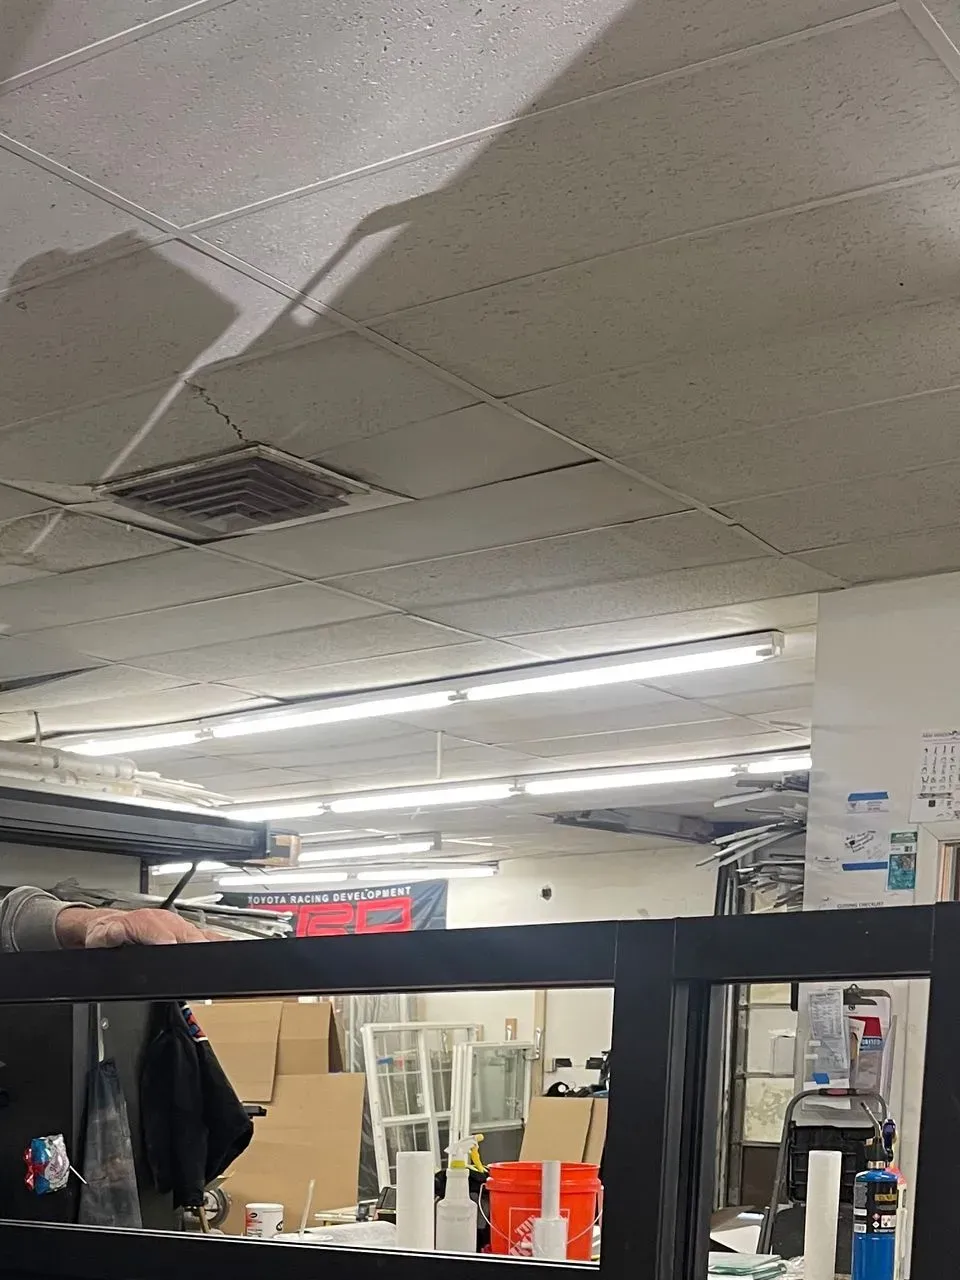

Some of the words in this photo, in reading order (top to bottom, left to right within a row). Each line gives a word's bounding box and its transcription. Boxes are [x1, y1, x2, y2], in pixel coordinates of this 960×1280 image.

[247, 896, 287, 905] TOYOTA
[290, 894, 329, 904] RACING
[333, 886, 412, 902] DEVELOPMENT
